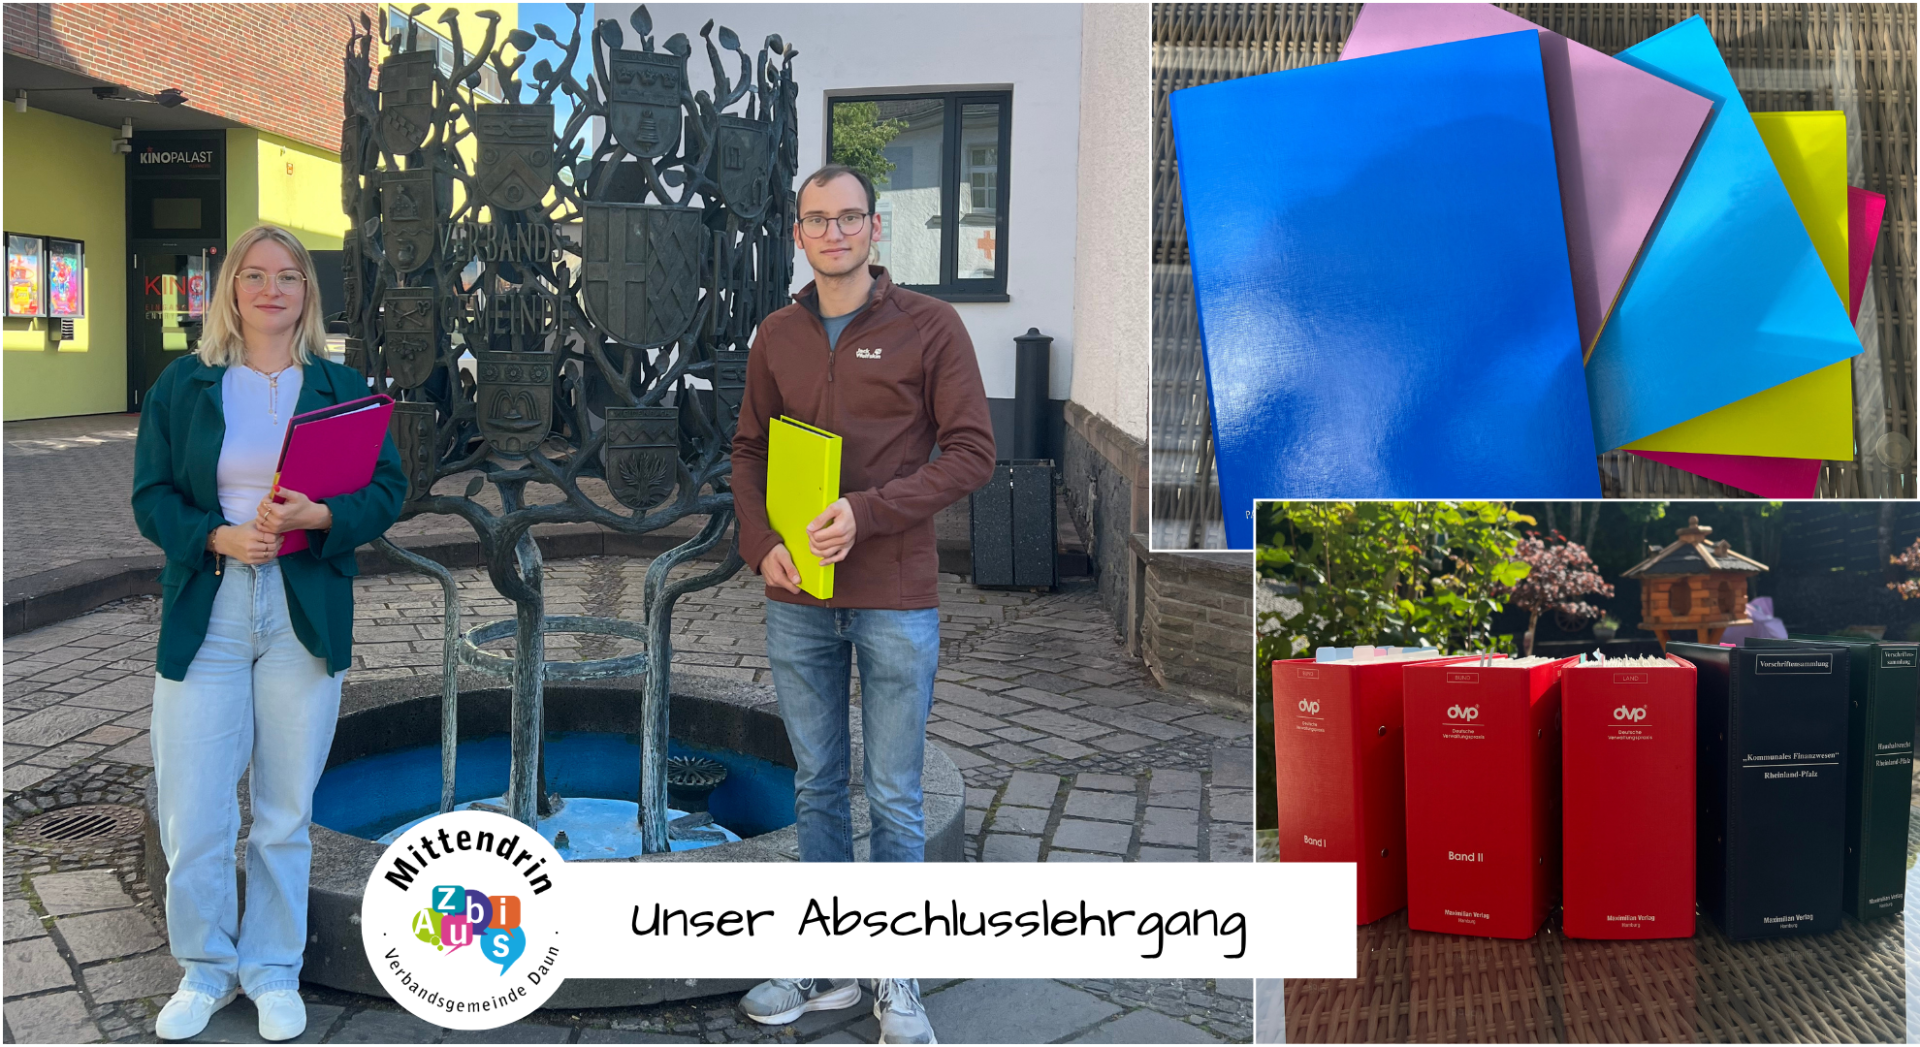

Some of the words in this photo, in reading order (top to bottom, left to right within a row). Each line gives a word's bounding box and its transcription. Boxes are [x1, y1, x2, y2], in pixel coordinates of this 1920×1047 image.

[140, 151, 213, 164] KINOPALAST
[437, 222, 564, 262] VERBANDS
[144, 275, 208, 296] KINO
[440, 293, 572, 335] GEMEINDE
[1760, 660, 1829, 669] Vorschriftensammlung
[1875, 757, 1911, 767] Rheinland-Pfalz
[1764, 770, 1819, 779] Rheinland-Pfalz
[1303, 834, 1323, 847] Band
[1448, 850, 1475, 862] Band
[1477, 852, 1484, 862] II
[1444, 909, 1473, 918] Maximilian
[1473, 911, 1490, 919] Verlag
[1763, 915, 1795, 924] Maximilian
[1796, 913, 1814, 921] Verlag
